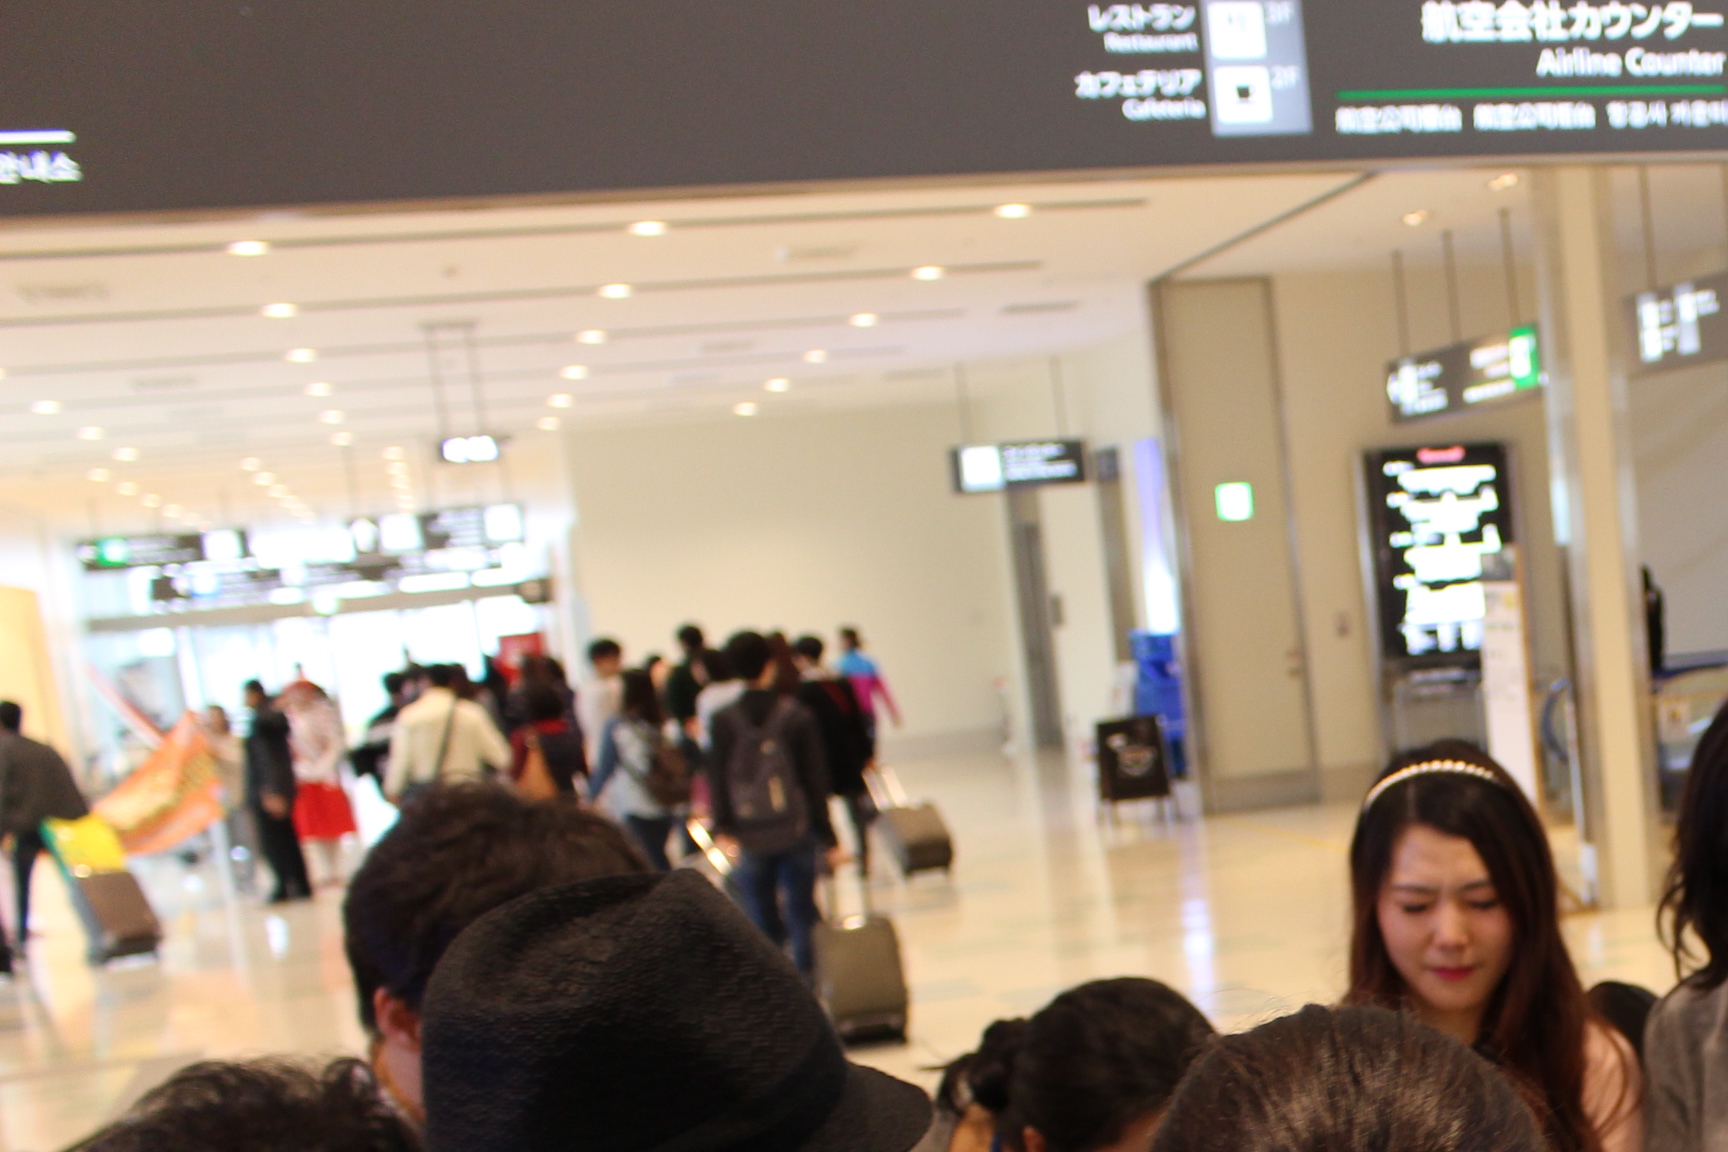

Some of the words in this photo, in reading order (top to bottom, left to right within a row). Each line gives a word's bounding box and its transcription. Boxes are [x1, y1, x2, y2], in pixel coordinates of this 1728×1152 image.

[1087, 4, 1196, 32] レストラン
[1421, 1, 1725, 43] 航空会社カウンター
[1535, 47, 1623, 77] Airline
[1624, 47, 1727, 76] Counter
[1074, 69, 1202, 99] カフェテリア
